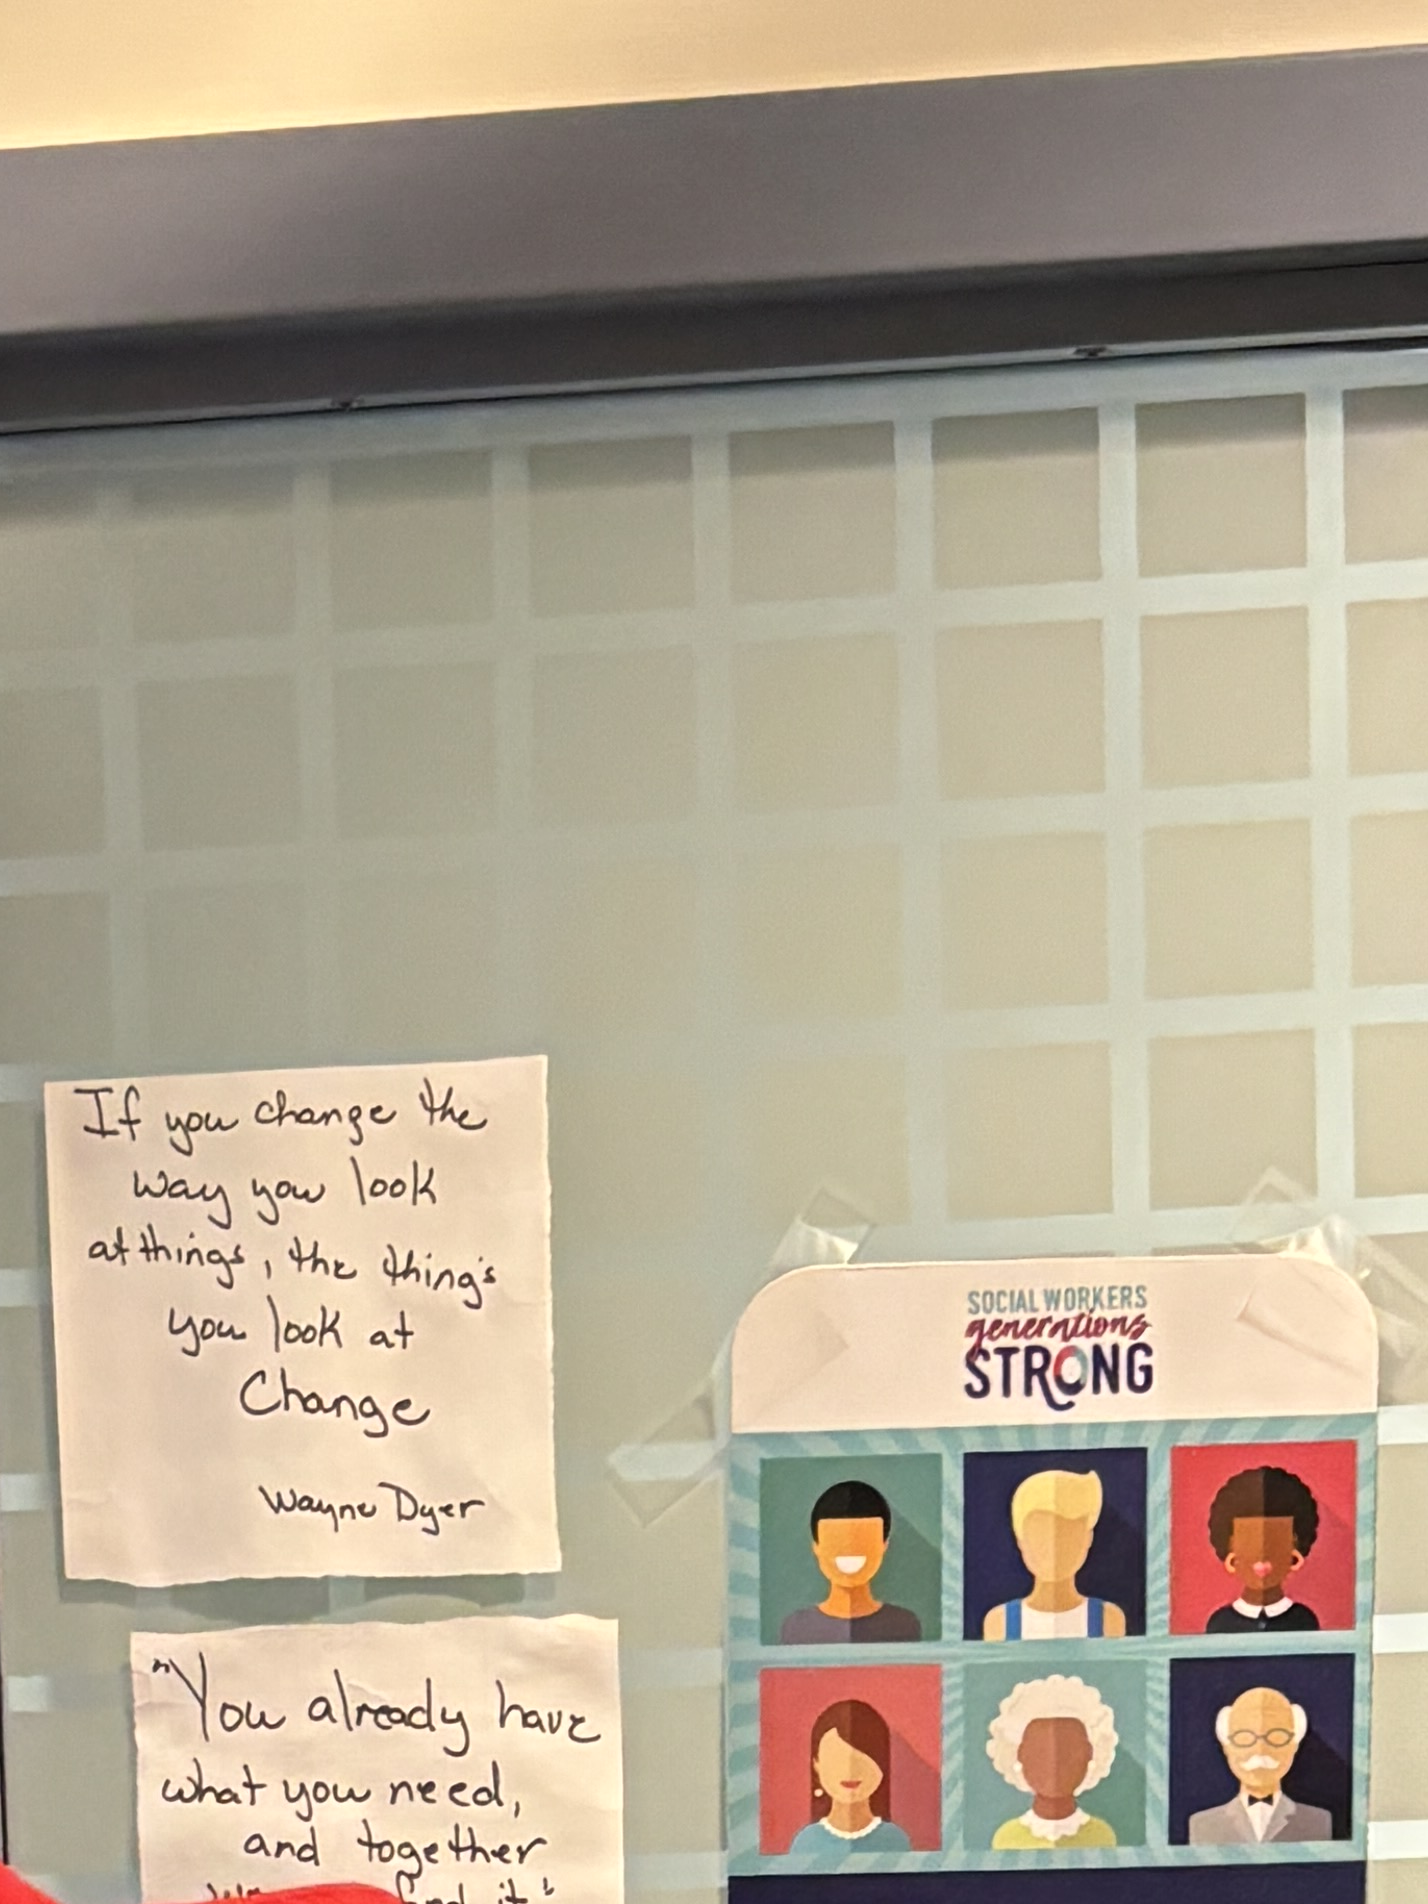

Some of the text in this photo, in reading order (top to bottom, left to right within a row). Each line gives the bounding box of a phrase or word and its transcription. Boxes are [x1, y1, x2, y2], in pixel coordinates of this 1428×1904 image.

[74, 1078, 488, 1156] If you change the
[133, 1156, 437, 1230] way you look
[288, 1236, 357, 1281] the
[168, 1294, 415, 1358] you look at
[967, 1285, 1148, 1315] SOCIAL WORKERS
[964, 1309, 1152, 1362] generations
[239, 1367, 432, 1440] Change
[964, 1342, 1153, 1411] STRONG
[258, 1482, 487, 1536] Wayne Dyer
[308, 1668, 471, 1758] already
[496, 1679, 602, 1744] have
[161, 1757, 522, 1822] what you need,
[243, 1818, 548, 1879] and together
